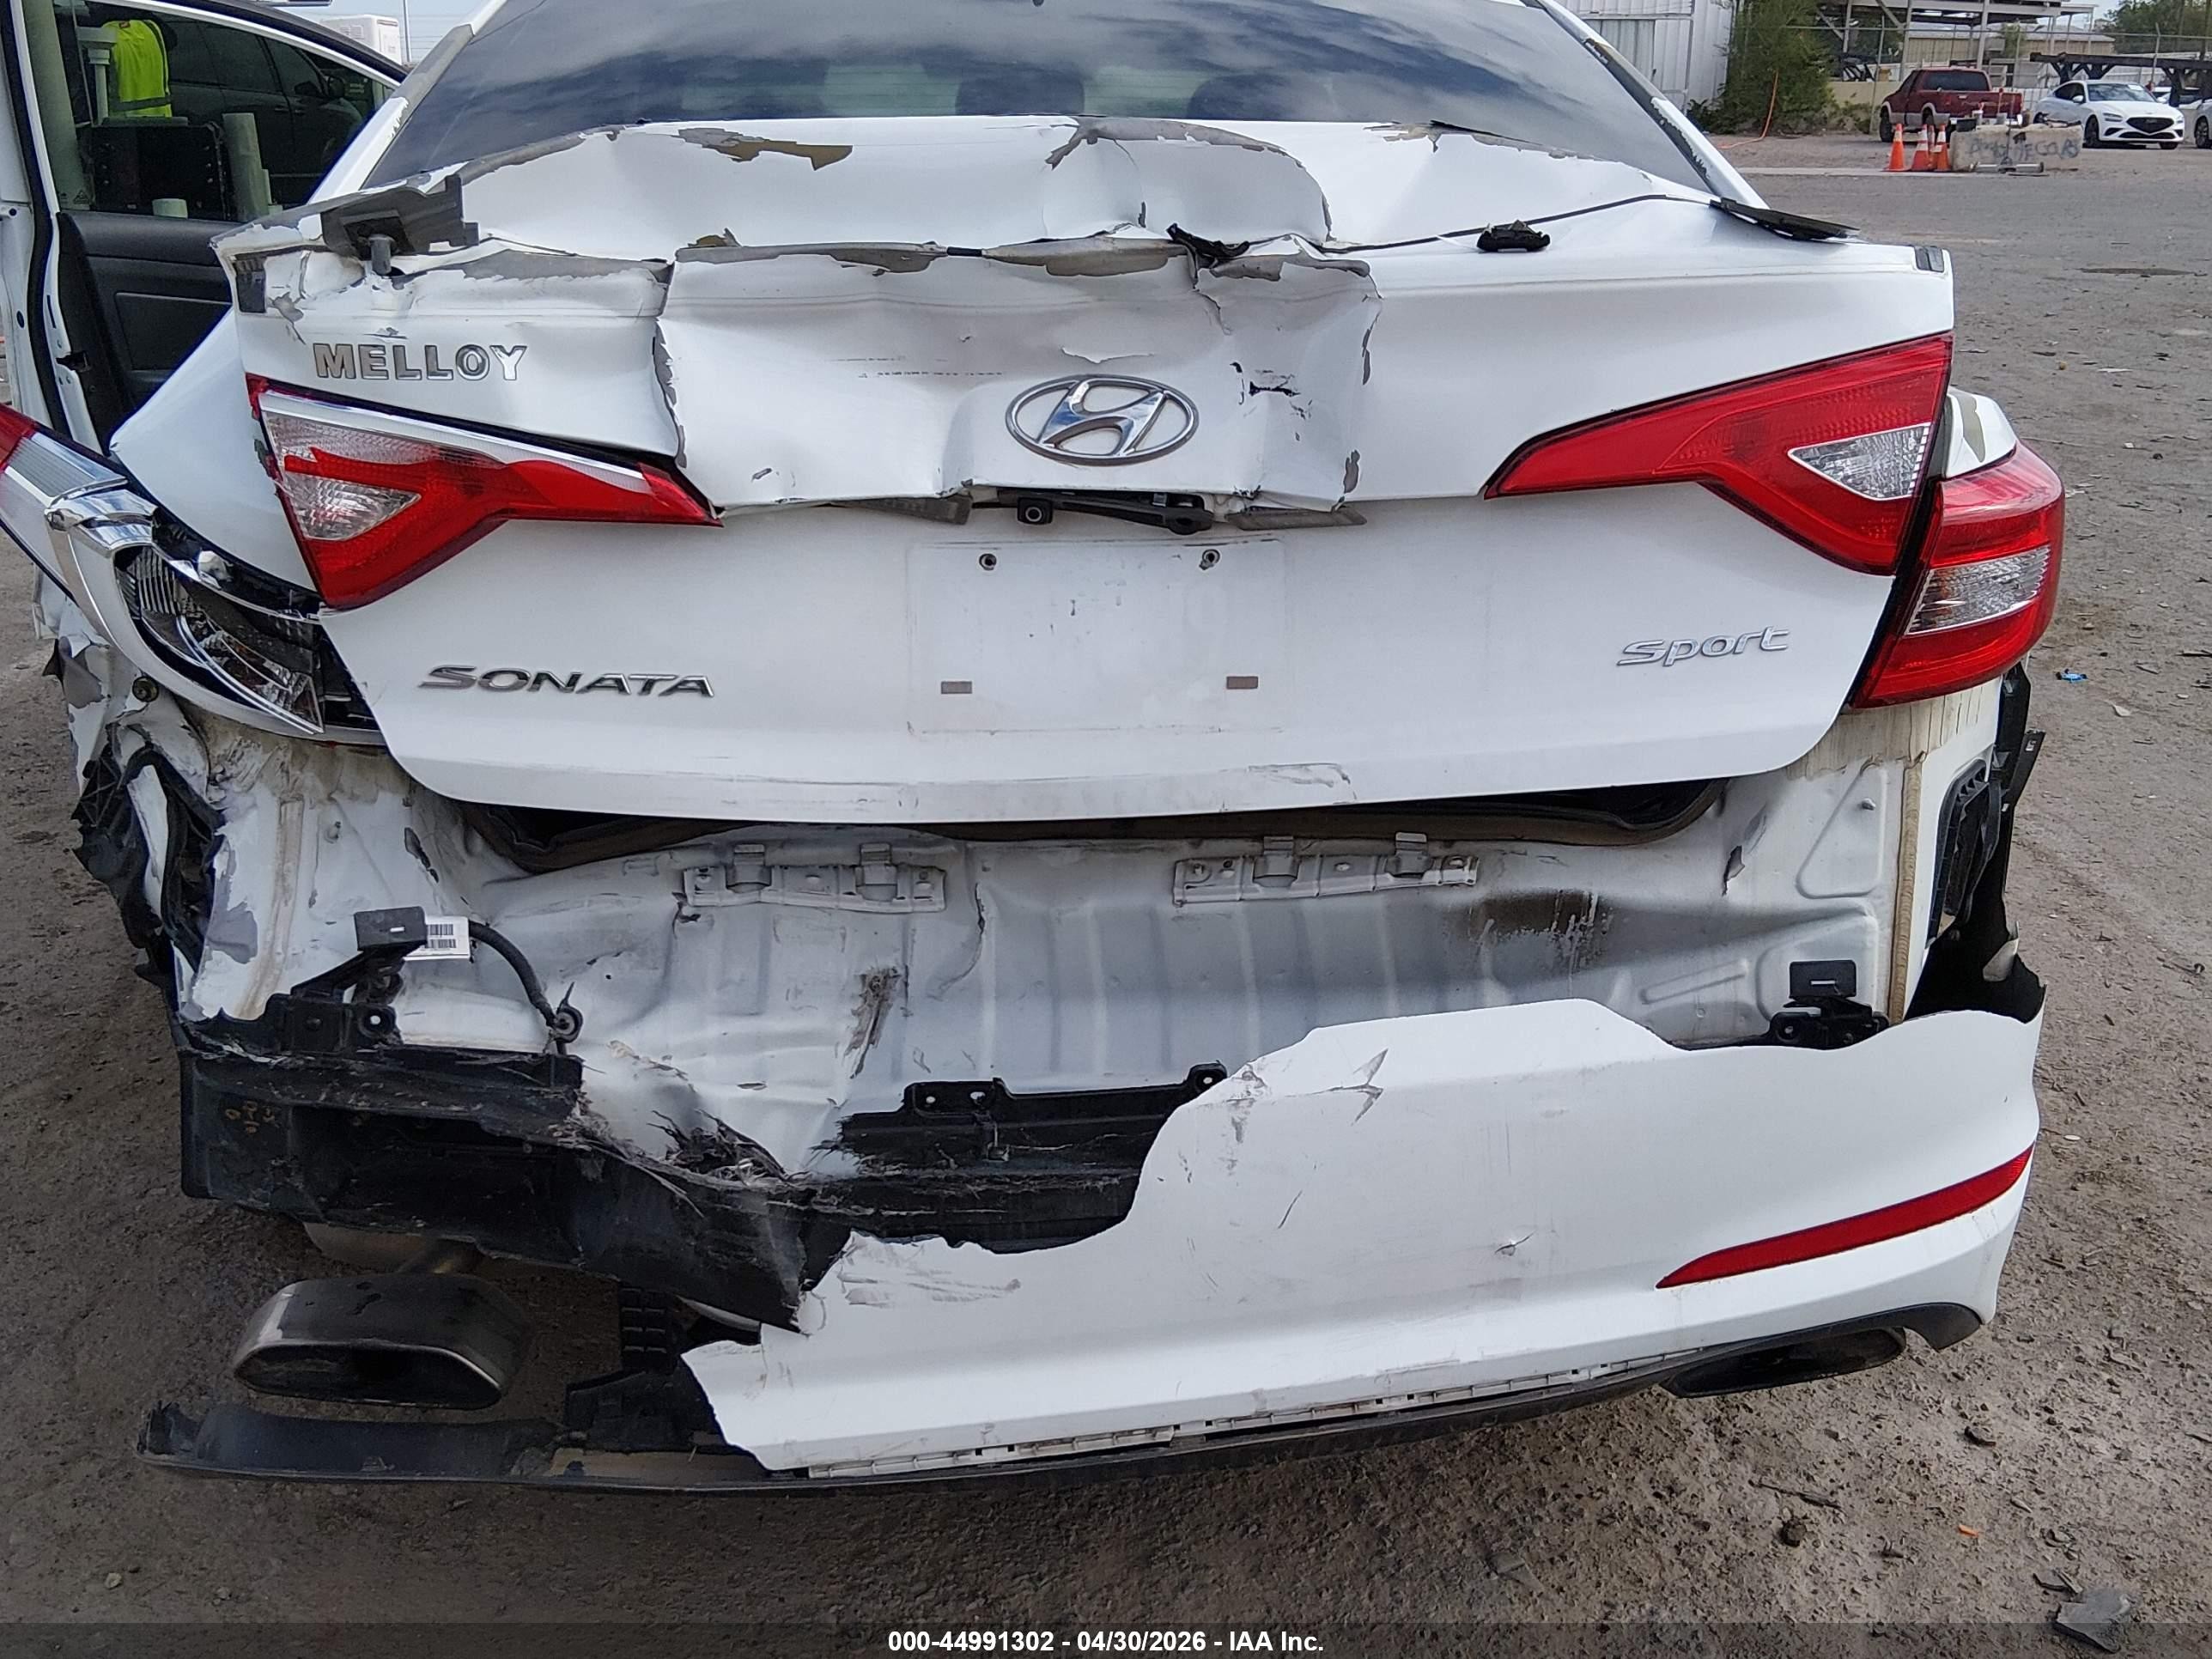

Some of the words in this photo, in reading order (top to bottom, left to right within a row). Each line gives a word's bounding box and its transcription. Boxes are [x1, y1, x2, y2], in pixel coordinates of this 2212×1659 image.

[313, 343, 527, 380] MELLOY
[1616, 626, 1790, 666] Sport
[417, 665, 715, 697] SONATA
